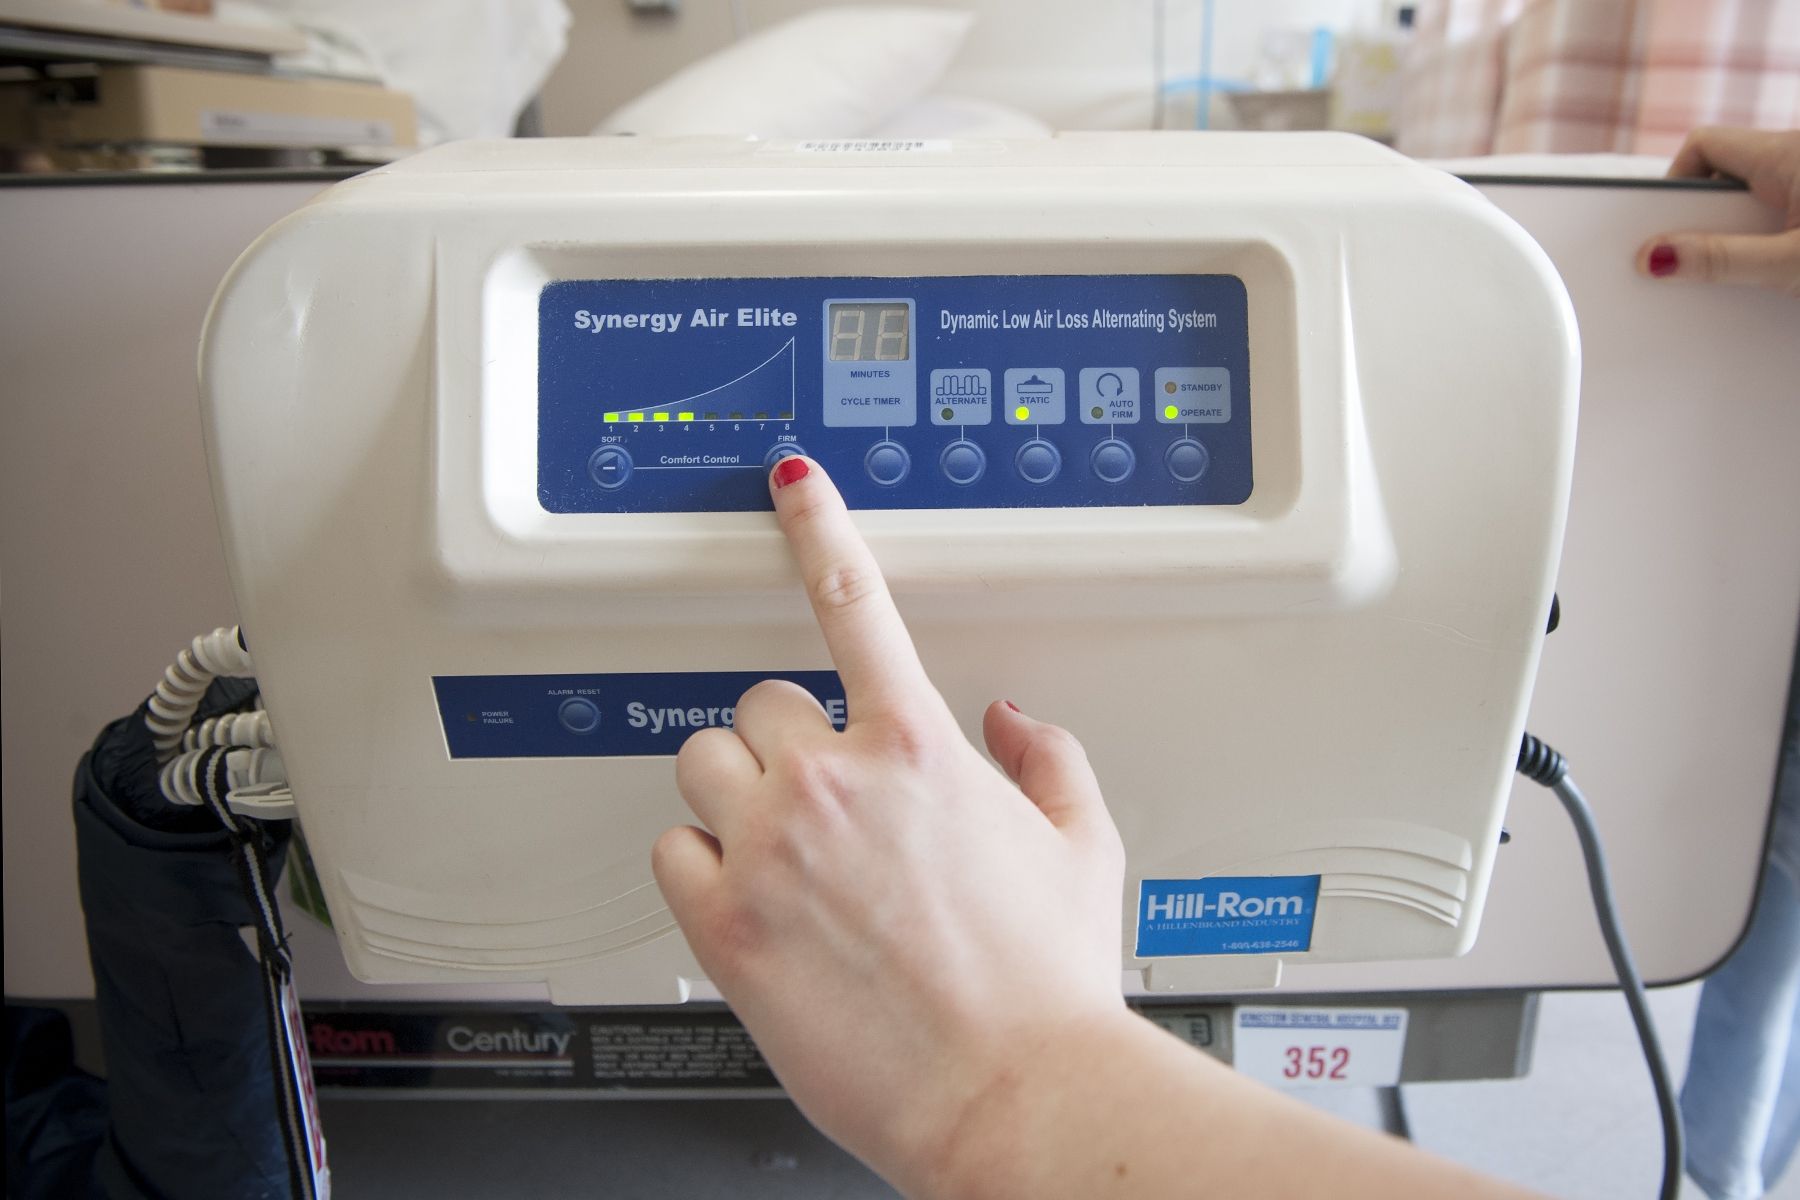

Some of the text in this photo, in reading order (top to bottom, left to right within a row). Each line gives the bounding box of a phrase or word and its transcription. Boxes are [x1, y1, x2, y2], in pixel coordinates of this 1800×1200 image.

[574, 307, 798, 333] Synergy Air Elite
[941, 308, 1217, 334] Dynamic Low Air Loss Alternating System
[850, 370, 890, 378] MINUTES
[1181, 383, 1223, 392] STANDBY
[841, 397, 901, 406] CYCLE TIMER
[935, 397, 988, 405] ALTERNATE
[1019, 396, 1050, 404] STATIC
[1109, 400, 1134, 408] AUTO
[1112, 411, 1134, 419] FIRM
[1181, 409, 1223, 417] OPERATE
[660, 454, 740, 464] Comfort Control
[627, 701, 736, 734] Synerg
[1147, 891, 1303, 920] Hill-Rom
[1156, 921, 1240, 931] HILLENBRAND
[1241, 918, 1302, 929] INDUSTRY
[446, 1026, 571, 1057] Century
[1283, 1047, 1350, 1080] 352
